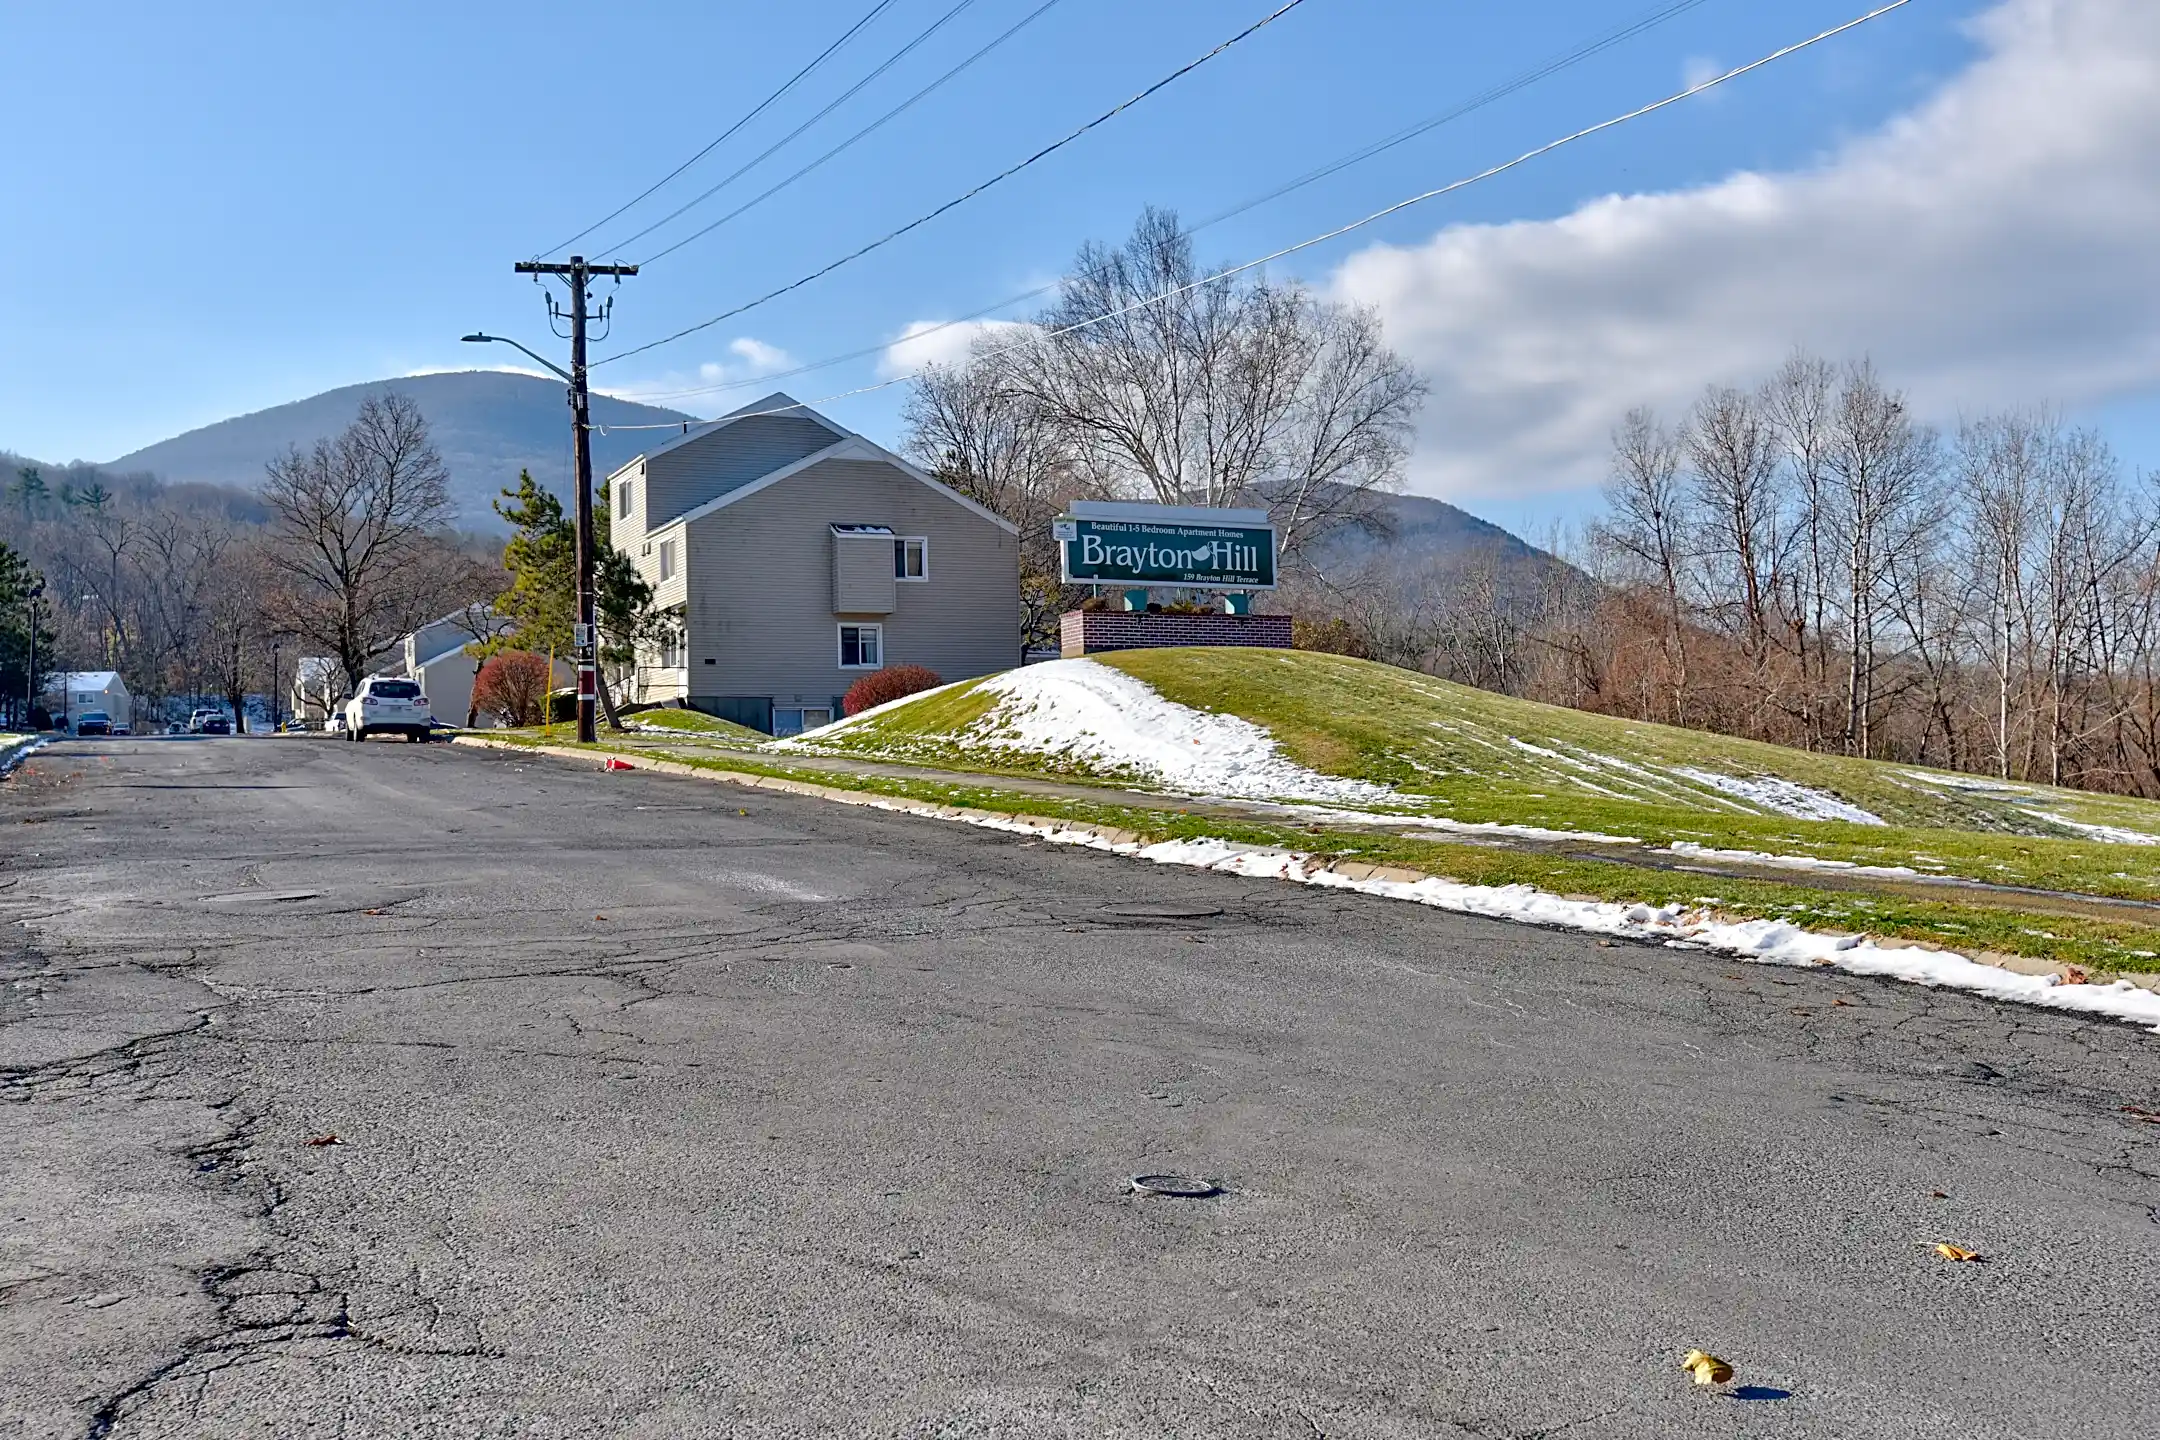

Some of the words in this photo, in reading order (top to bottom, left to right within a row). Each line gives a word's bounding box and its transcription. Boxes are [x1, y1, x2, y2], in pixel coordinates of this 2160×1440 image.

[1091, 521, 1127, 532] Beautiful
[1128, 524, 1140, 532] 1-5
[1142, 525, 1176, 535] Bedroom
[1177, 528, 1216, 537] Apartment
[1218, 530, 1244, 538] Homes
[1082, 535, 1193, 574] Brayton
[1211, 540, 1258, 572] Hill
[1196, 574, 1220, 583] Brayton
[1222, 574, 1236, 582] Hill
